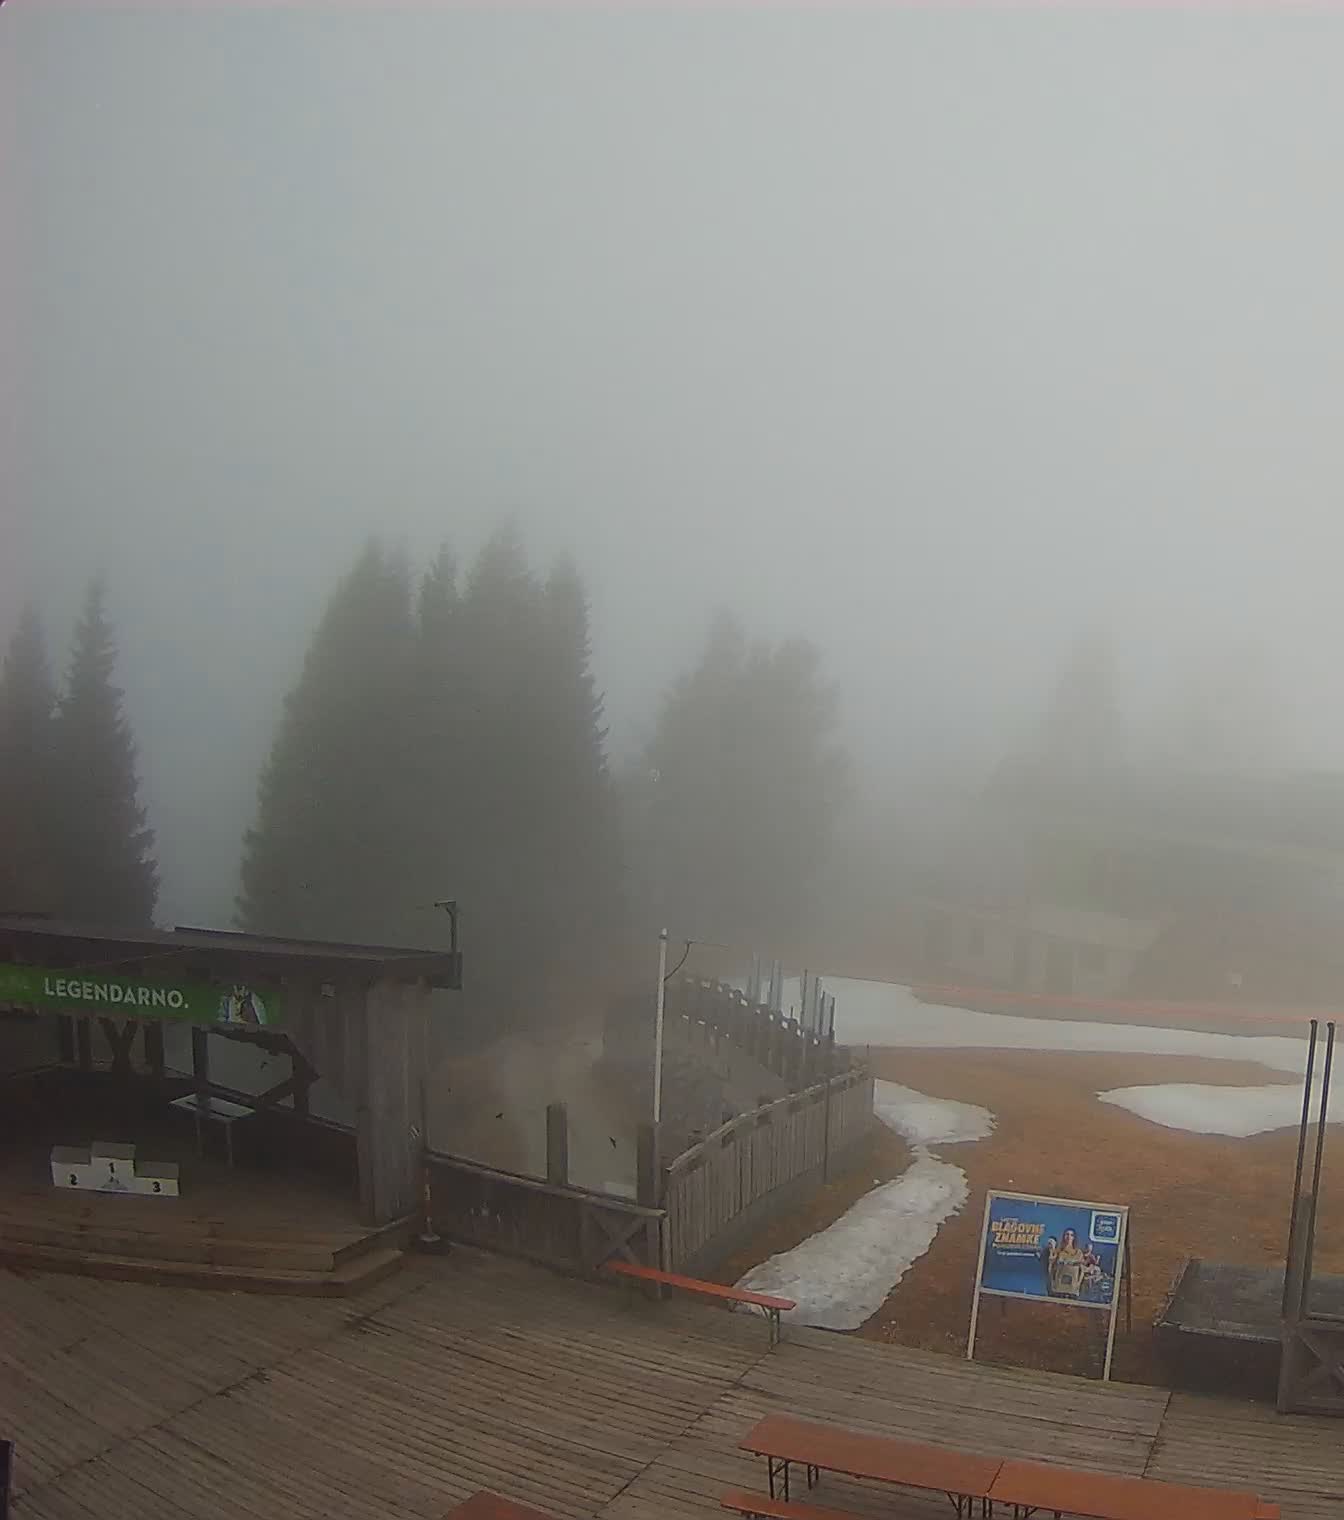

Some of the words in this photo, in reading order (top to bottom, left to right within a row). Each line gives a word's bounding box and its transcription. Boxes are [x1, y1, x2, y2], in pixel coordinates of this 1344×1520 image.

[44, 977, 189, 1009] LEGENDARNO.
[108, 1162, 115, 1174] 1
[69, 1174, 78, 1186] 2
[152, 1181, 161, 1193] 3
